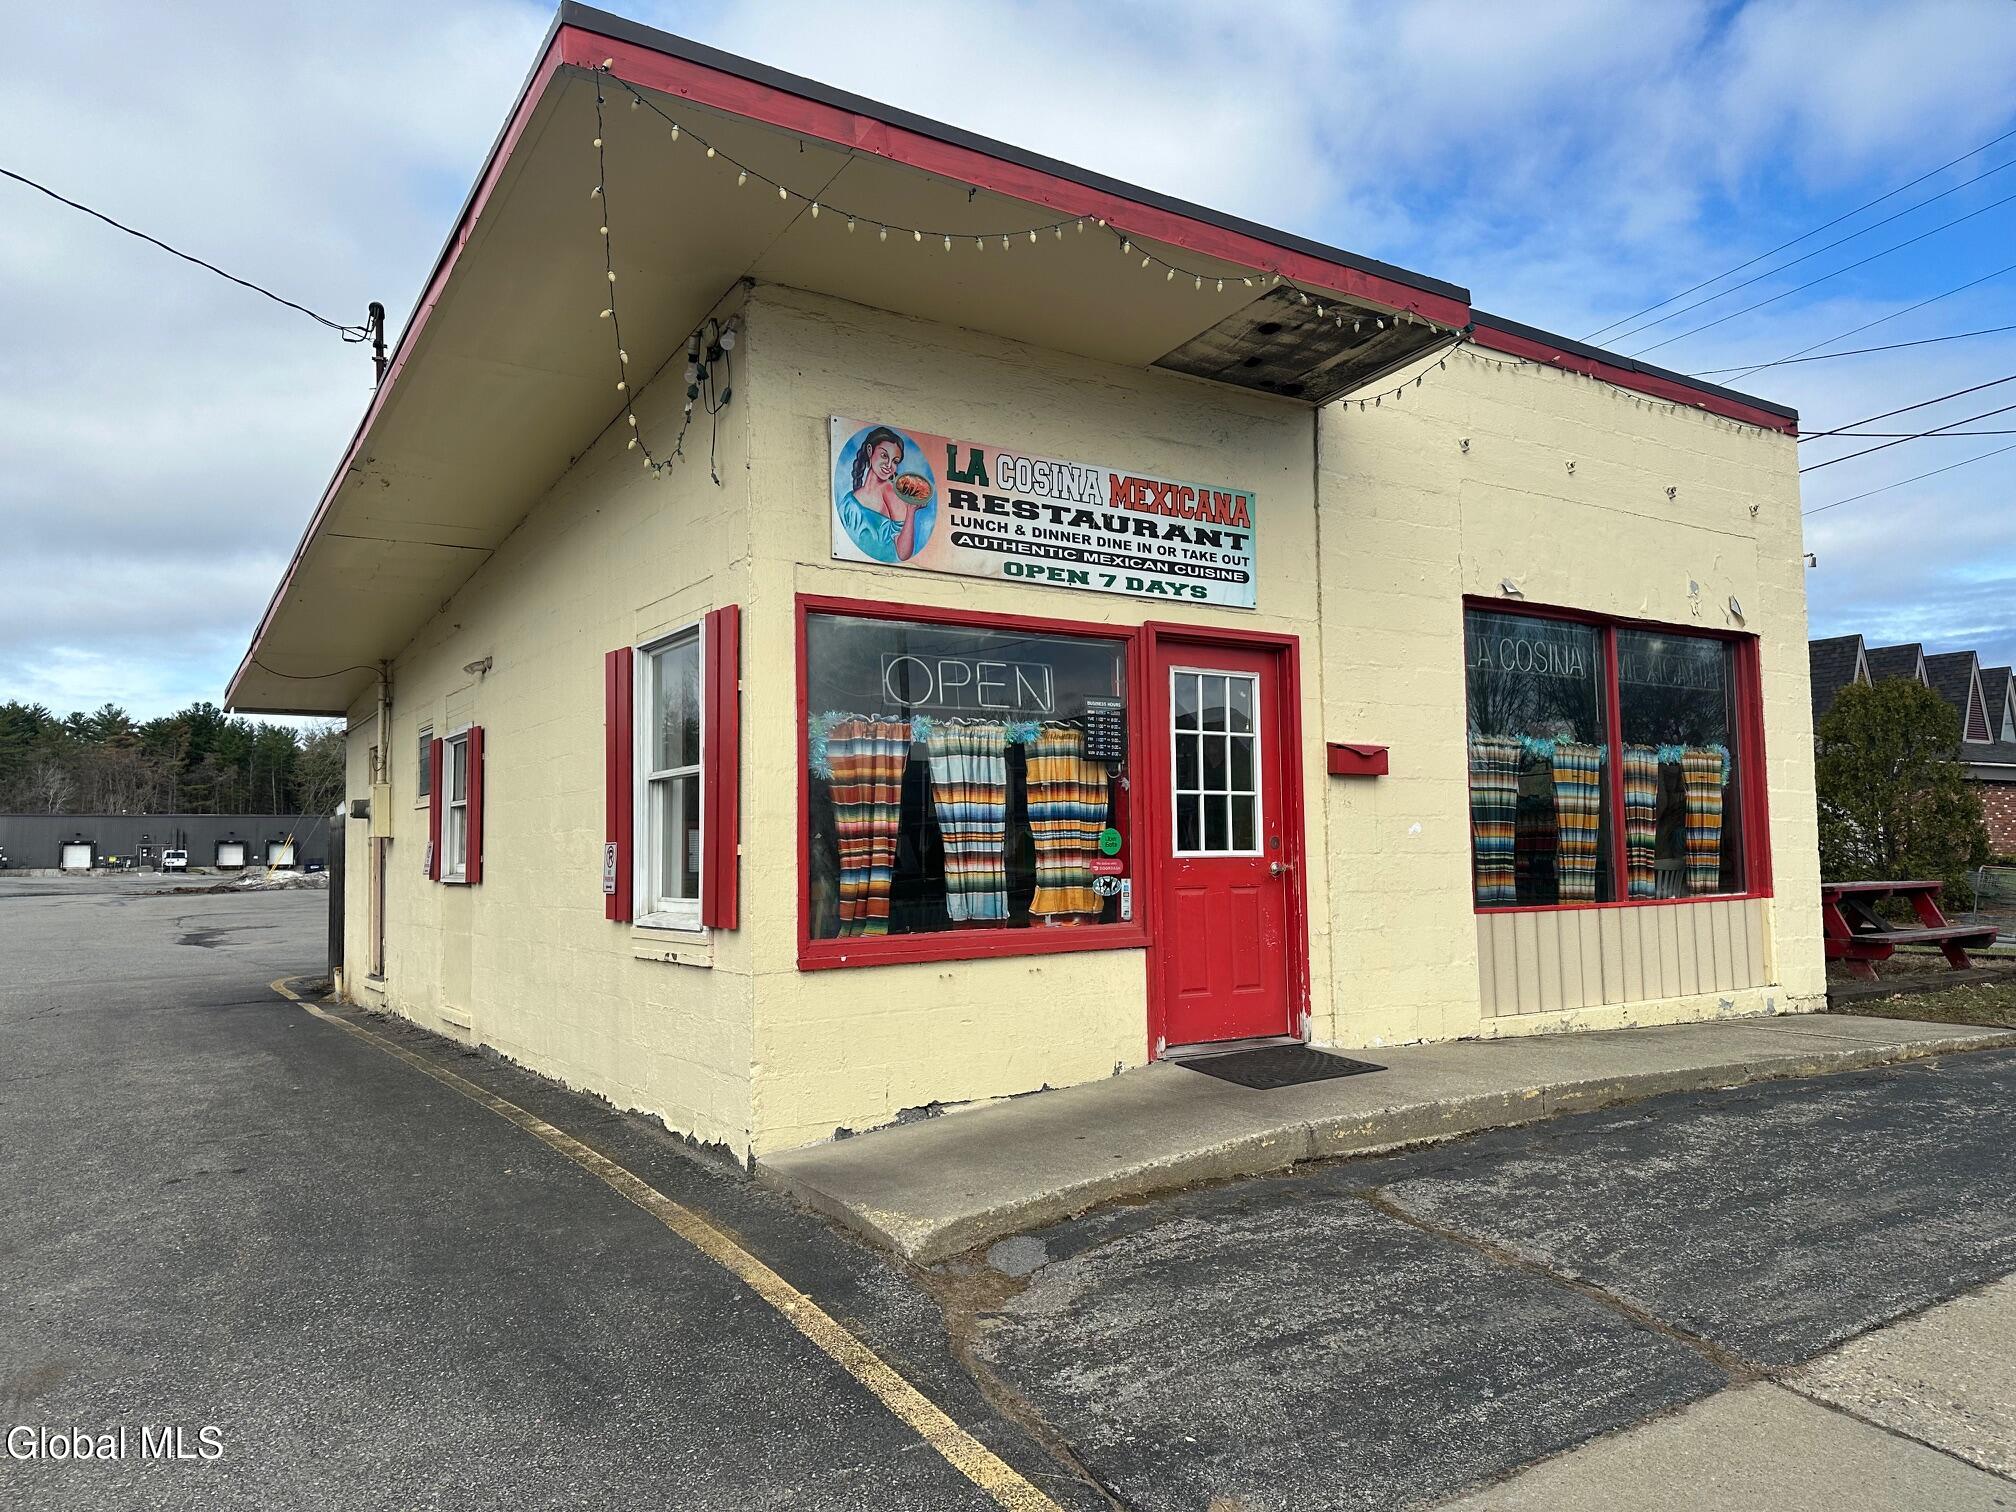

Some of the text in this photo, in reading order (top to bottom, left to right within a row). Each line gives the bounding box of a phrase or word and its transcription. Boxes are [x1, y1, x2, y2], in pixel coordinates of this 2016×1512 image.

[946, 444, 1251, 528] LA COSINA MEXICANA
[948, 488, 1249, 551] RESTAURANT
[950, 514, 1249, 567] LUNCH & DINNER DINE IN OR TAKE OUT
[957, 535, 1245, 582] AUTHENTIC MEXICAN CUISINE
[1004, 561, 1208, 599] OPEN 7 DAYS
[886, 656, 1051, 710] OPEN
[1499, 638, 1585, 676] COSINA
